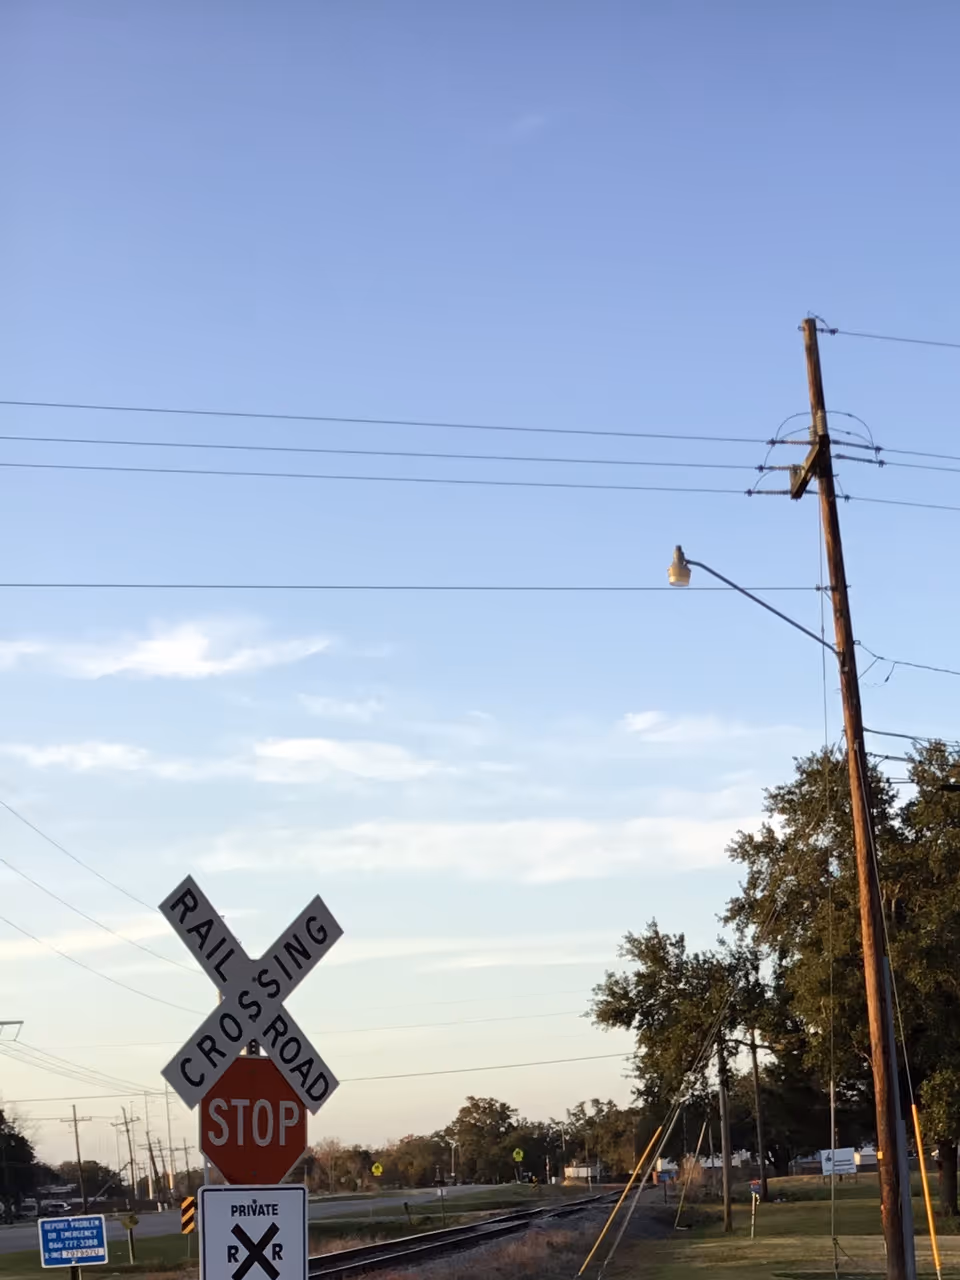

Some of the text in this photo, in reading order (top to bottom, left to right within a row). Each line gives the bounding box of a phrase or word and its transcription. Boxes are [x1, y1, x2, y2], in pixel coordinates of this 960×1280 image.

[169, 887, 329, 1102] RAIL ROAD
[180, 915, 328, 1088] CROSSING
[207, 1098, 300, 1146] STOP
[231, 1204, 279, 1217] PRIVATE
[227, 1245, 240, 1263] R
[272, 1243, 283, 1260] R
